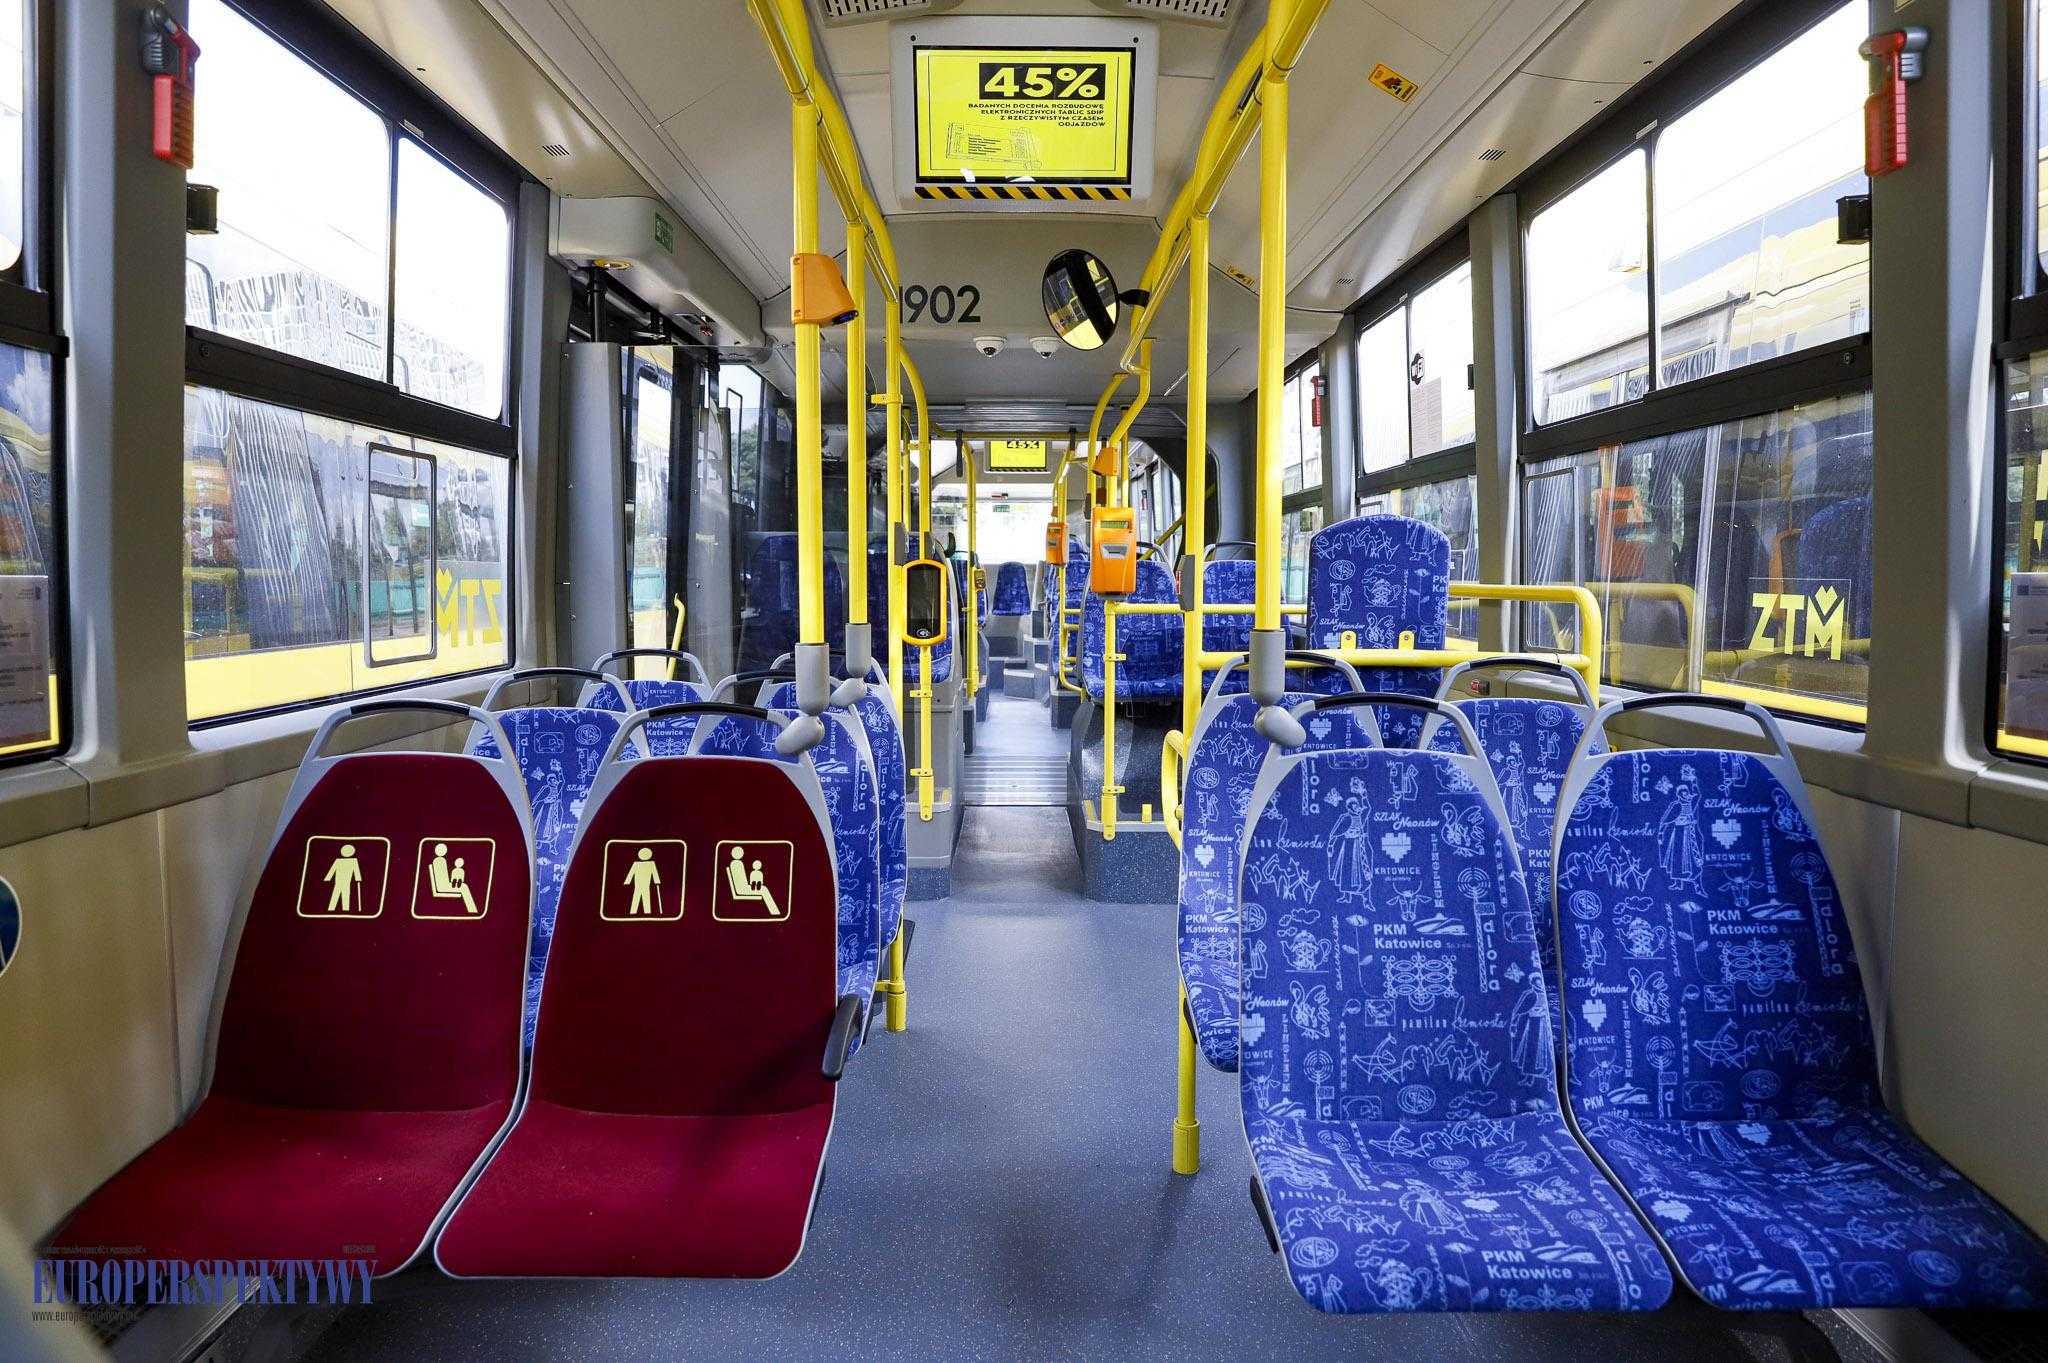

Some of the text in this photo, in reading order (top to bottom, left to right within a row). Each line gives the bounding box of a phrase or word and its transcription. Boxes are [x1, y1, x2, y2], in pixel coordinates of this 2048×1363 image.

[984, 67, 1100, 98] 45%
[1748, 588, 1845, 660] ZTM
[1705, 853, 1752, 861] KATOWICE
[1375, 867, 1421, 875] KATOWICE
[1186, 915, 1208, 924] PKM
[1707, 910, 1741, 920] PKM
[1186, 924, 1229, 934] Katowice
[1373, 924, 1408, 935] PKM
[1709, 924, 1778, 935] Katowice
[1374, 938, 1442, 949] Katowice
[1578, 1035, 1616, 1046] KATOWICE
[1583, 1096, 1605, 1111] PKM
[1481, 1250, 1527, 1263] PKM
[1487, 1265, 1573, 1280] Katowice
